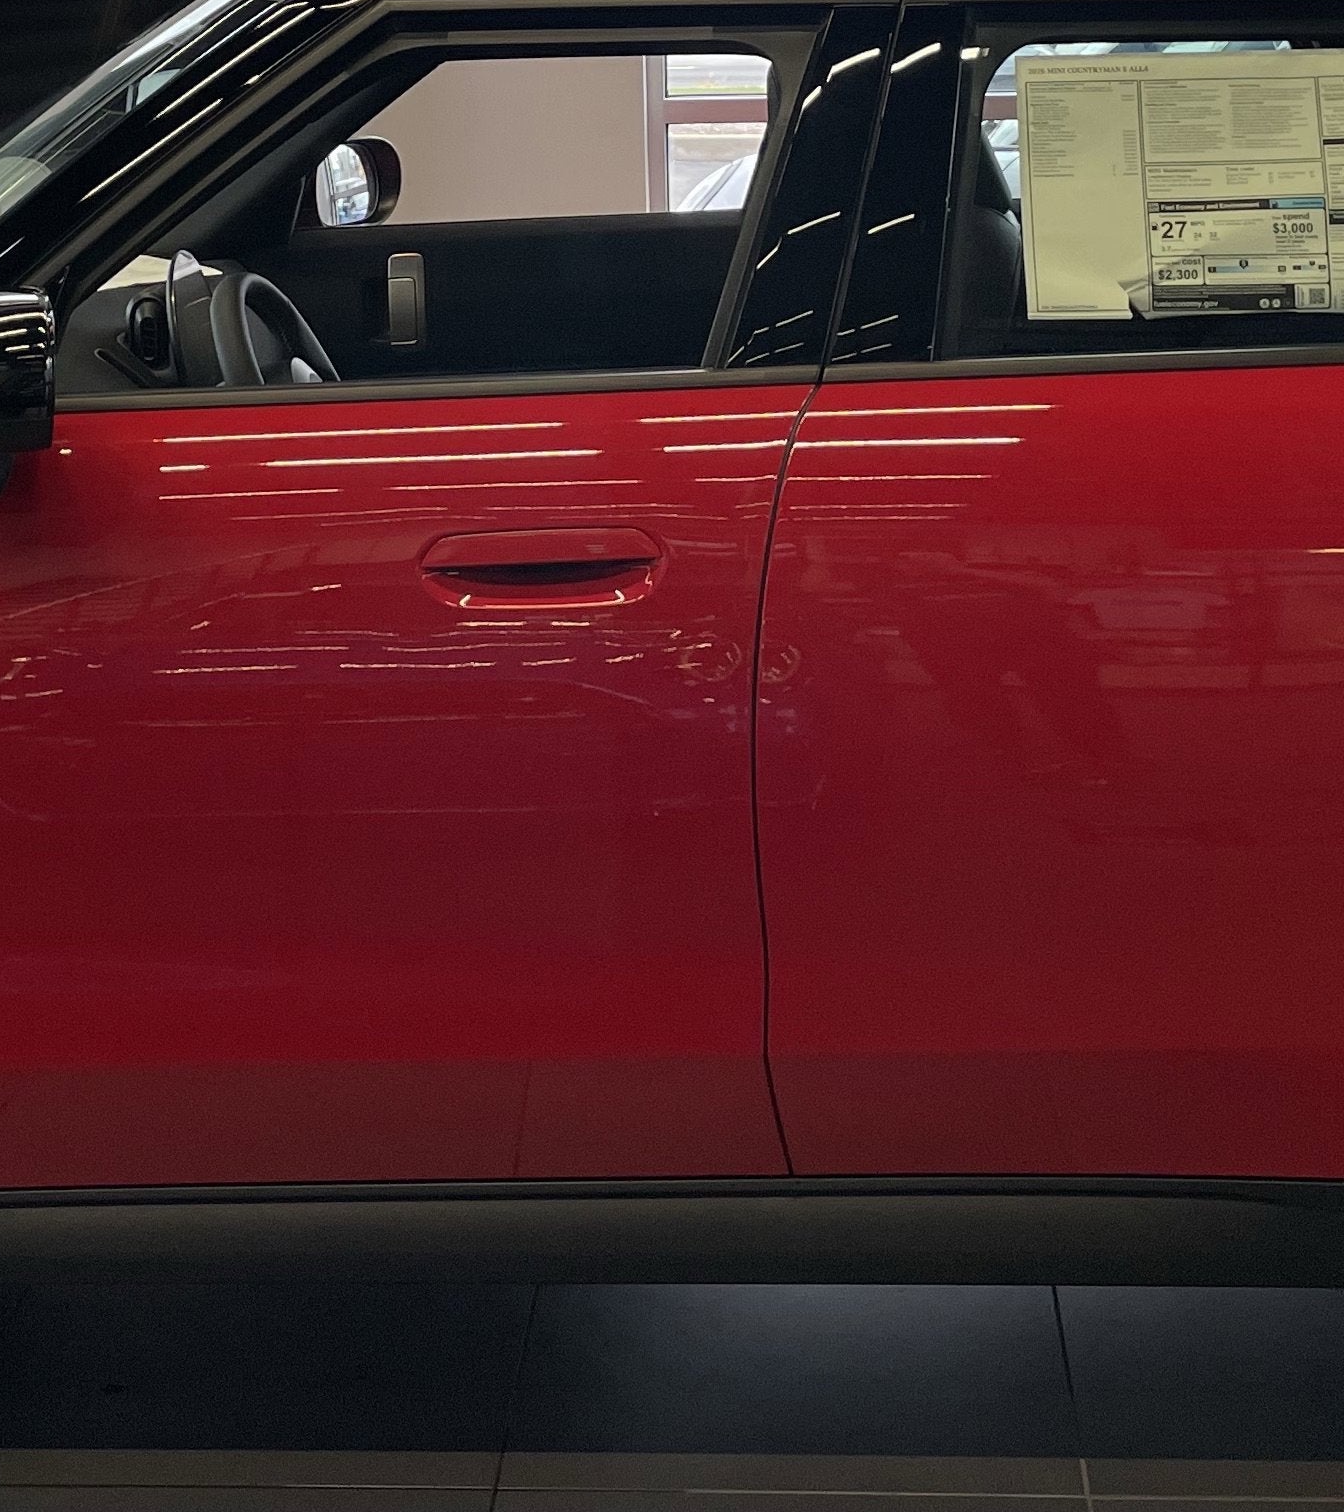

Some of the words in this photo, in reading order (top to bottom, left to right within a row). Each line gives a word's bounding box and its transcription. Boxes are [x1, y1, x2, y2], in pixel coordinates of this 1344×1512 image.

[1067, 66, 1121, 74] COUNTRYMAN
[1160, 220, 1187, 239] 27
[1272, 222, 1314, 235] $3,000
[1158, 269, 1198, 281] $2,300
